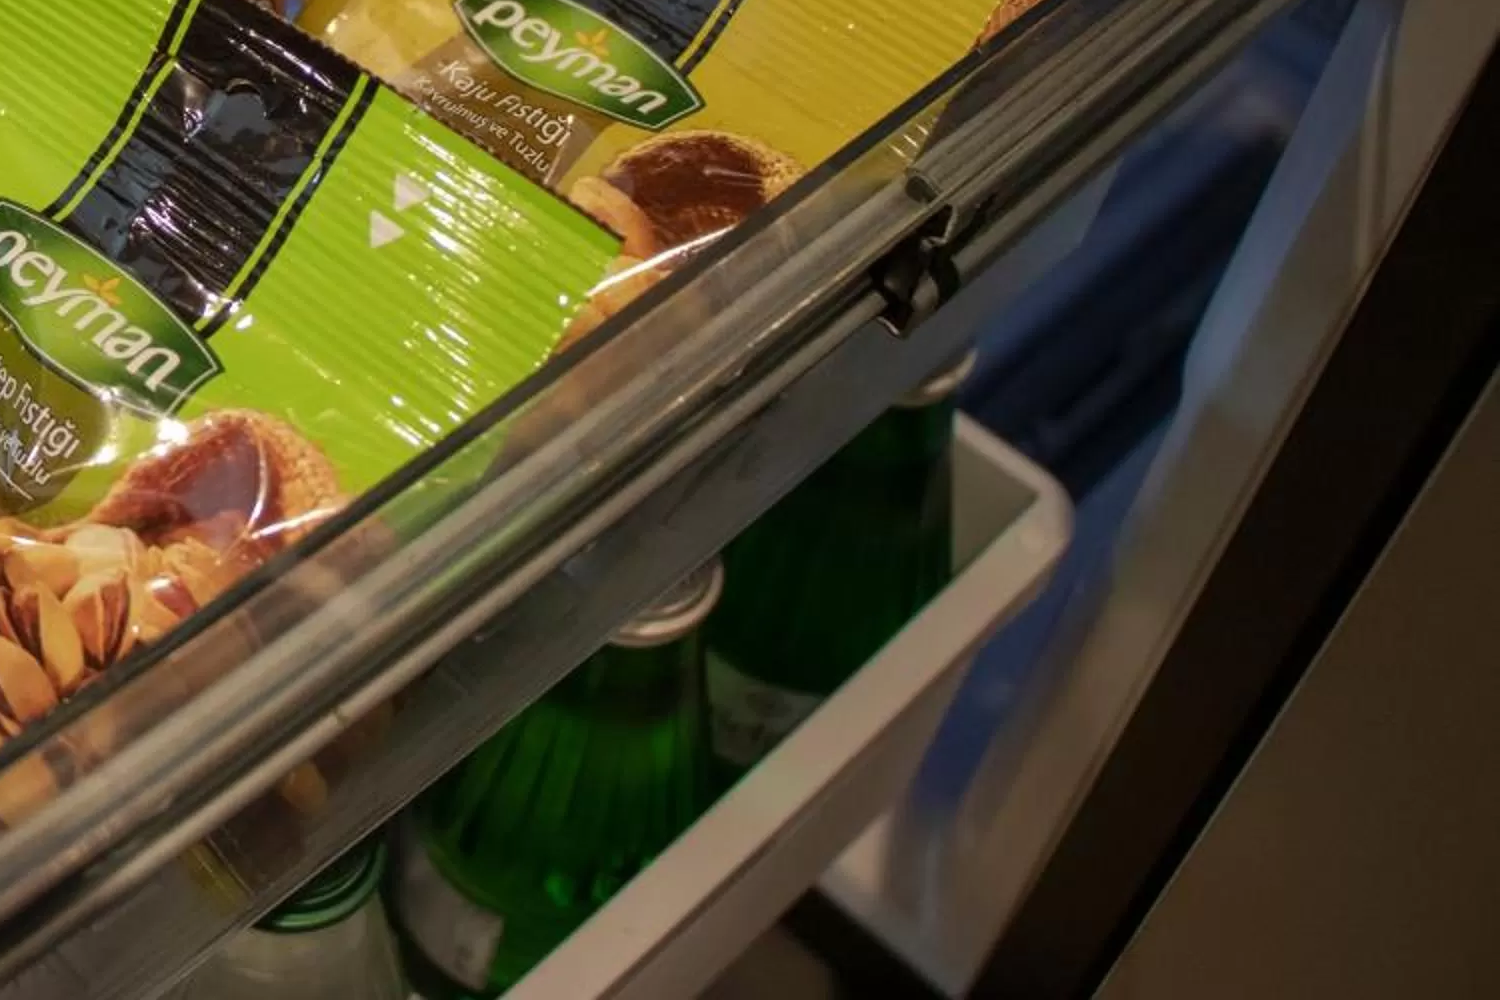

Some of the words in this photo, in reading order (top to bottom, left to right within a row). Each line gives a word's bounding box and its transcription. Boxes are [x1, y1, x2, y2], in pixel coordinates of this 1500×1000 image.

[439, 59, 498, 102] Kaju
[488, 122, 511, 141] ve
[508, 132, 550, 173] Tuzlu
[13, 382, 81, 460] Fıstığı
